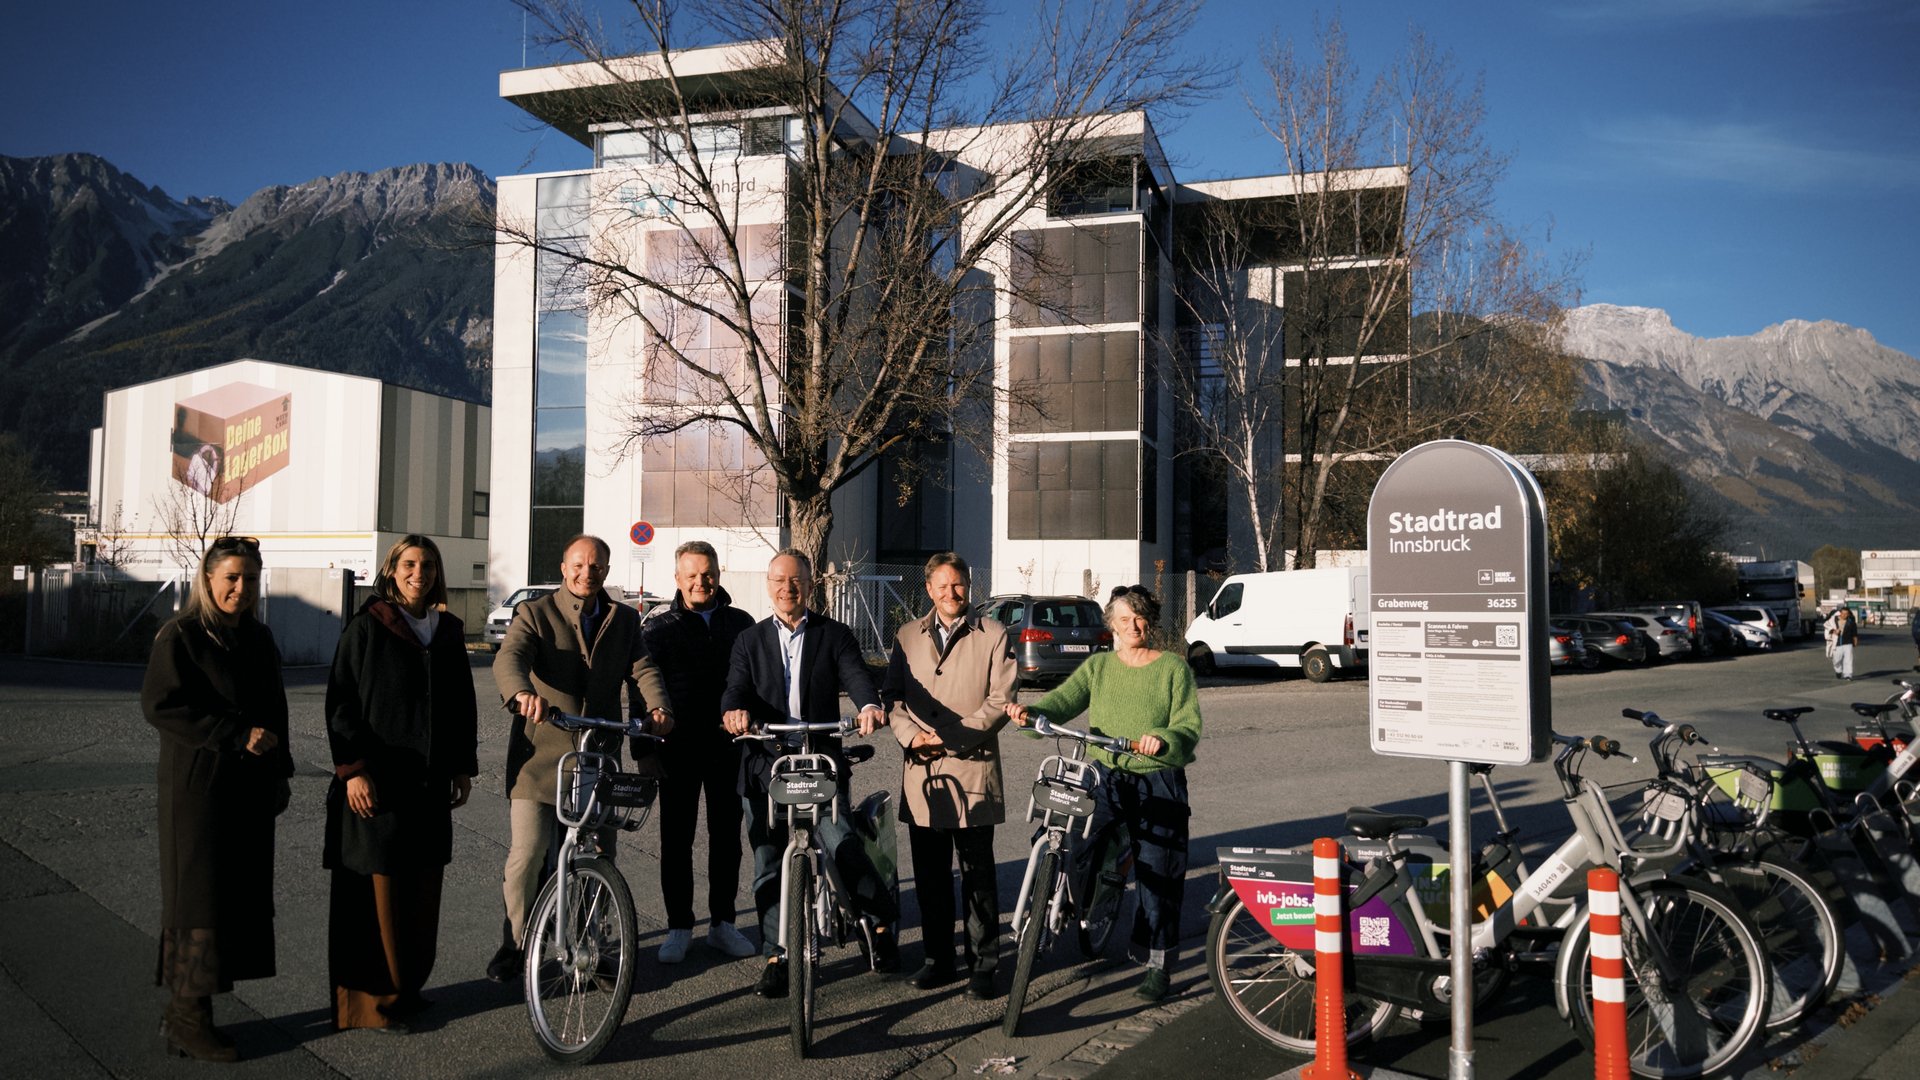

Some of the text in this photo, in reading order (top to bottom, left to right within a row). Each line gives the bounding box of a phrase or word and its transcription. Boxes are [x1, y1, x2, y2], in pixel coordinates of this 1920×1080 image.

[682, 177, 756, 196] Lenhard
[225, 415, 262, 452] Deine
[224, 429, 288, 484] LagerBox
[1388, 505, 1502, 534] Stadtrad
[1389, 533, 1471, 553] Innsbruck
[1377, 598, 1517, 611] Grabenweg 36255
[613, 784, 642, 793] Stadtrad
[786, 780, 819, 789] Stadtrad
[1050, 789, 1080, 803] Stadtrad
[1357, 849, 1384, 857] Stadtrad
[1229, 864, 1257, 873] Stadtrad
[1256, 890, 1315, 909] ivb-jobs.
[1276, 912, 1315, 920] Jetzt bewer
